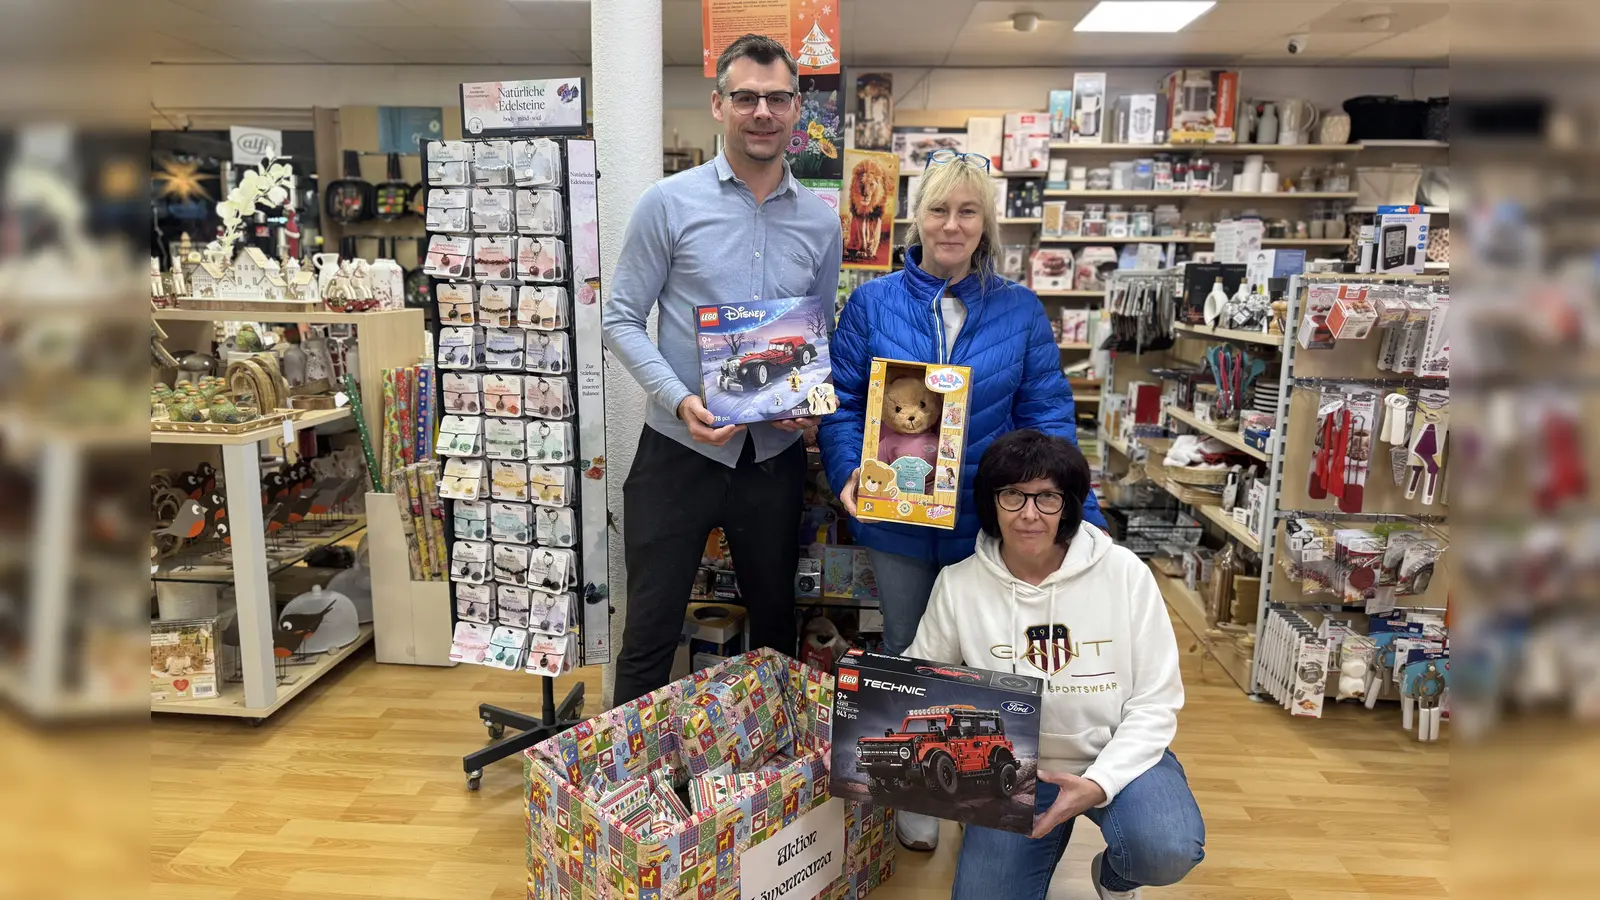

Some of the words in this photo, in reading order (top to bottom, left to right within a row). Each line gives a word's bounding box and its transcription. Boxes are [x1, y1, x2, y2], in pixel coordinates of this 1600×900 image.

[498, 87, 545, 99] Natürliche
[499, 100, 545, 112] Edelsteine
[243, 138, 268, 155] alfi
[701, 313, 717, 321] LEGO
[930, 373, 962, 387] BABY
[1031, 627, 1063, 638] 199
[990, 640, 1112, 660] GANT
[840, 674, 857, 684] LEGO
[863, 678, 926, 697] TECHNIC
[1049, 682, 1118, 694] SPORTSWEAR
[837, 691, 848, 700] 9+
[836, 709, 847, 718] 943
[1007, 702, 1029, 713] Ford
[777, 830, 817, 866] Aktion
[751, 851, 832, 900] öwenmama
